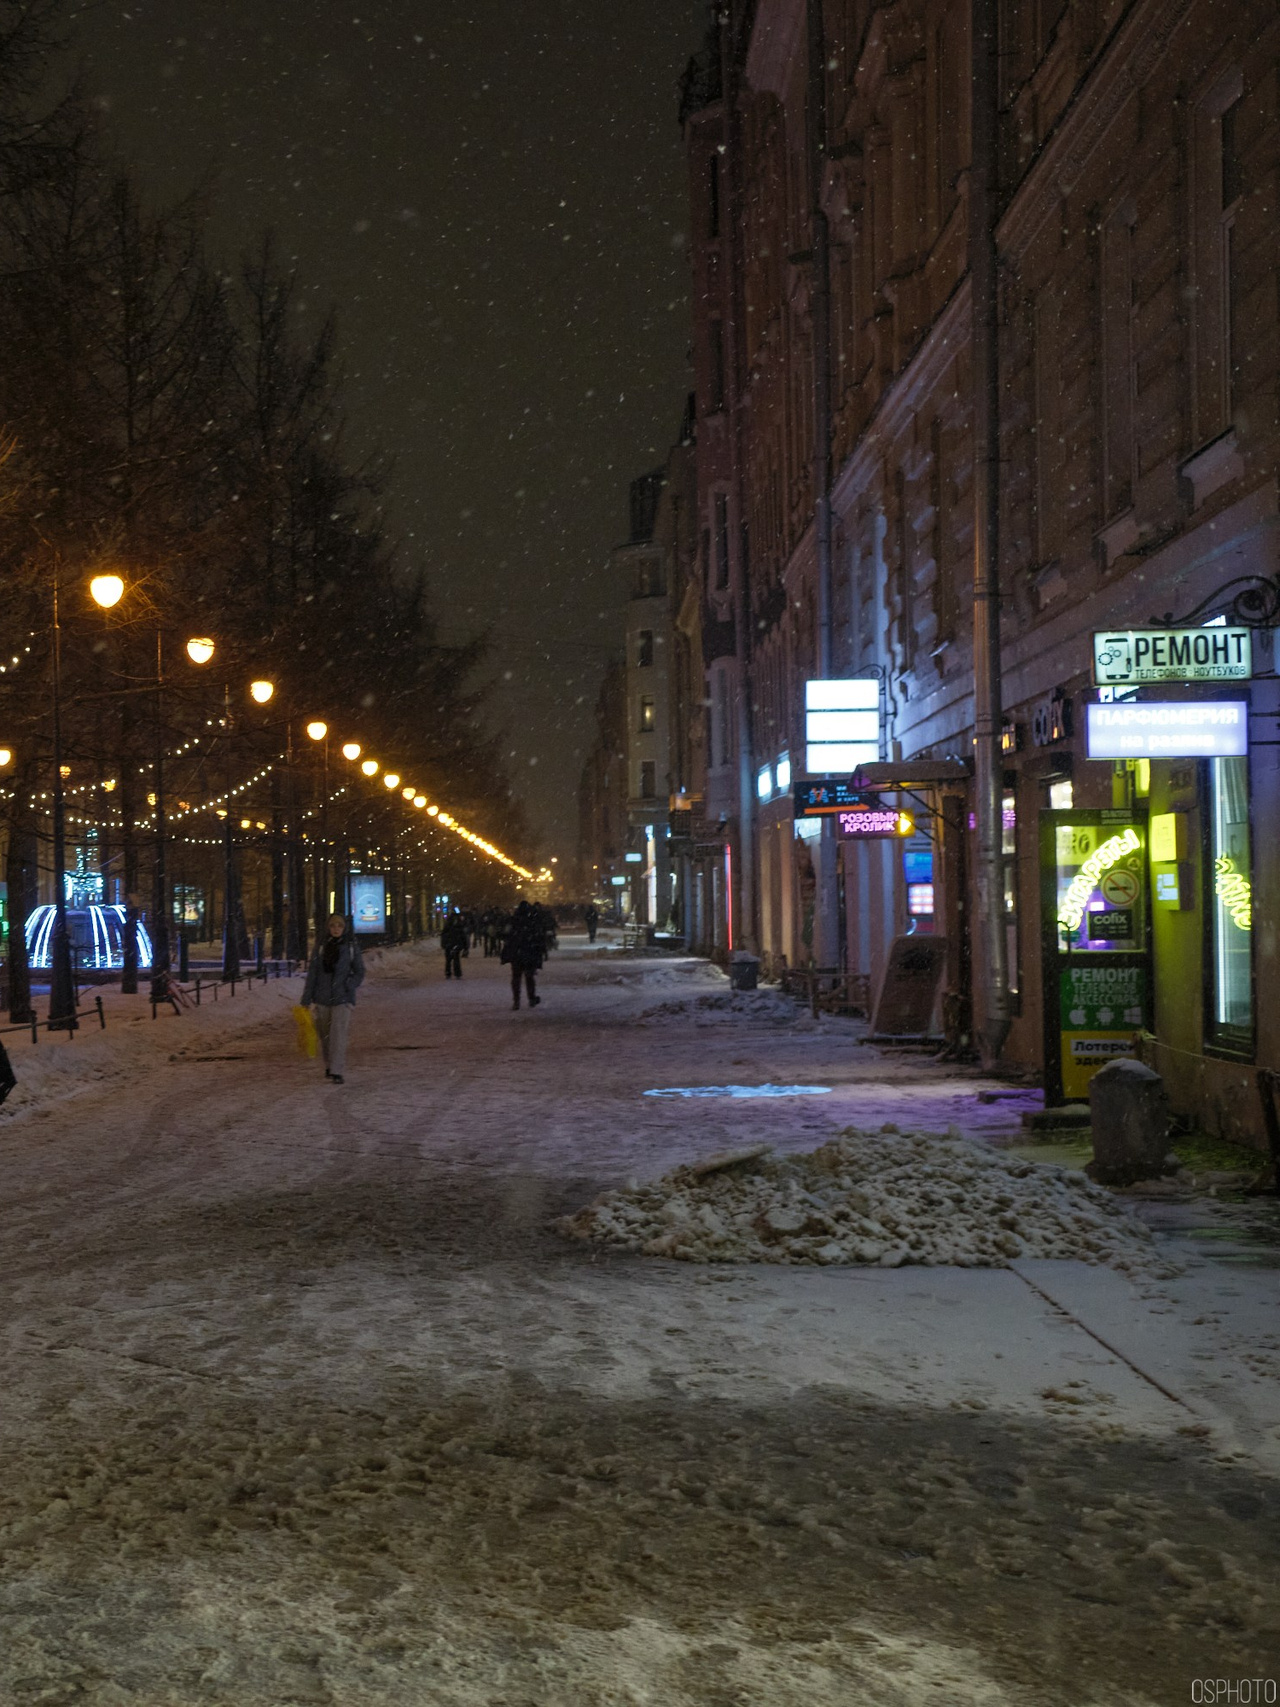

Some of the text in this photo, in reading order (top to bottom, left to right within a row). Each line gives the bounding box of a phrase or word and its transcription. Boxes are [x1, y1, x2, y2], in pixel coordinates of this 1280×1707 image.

[1135, 633, 1247, 668] РЕМОНТ
[1135, 666, 1246, 679] ТЕЛЕФОНОВ НОУТБУКОВ
[1096, 708, 1239, 726] ПАРФЮМЕРИЯ
[1120, 734, 1215, 751] на разлив
[840, 811, 899, 824] РОЗОВЫЙ
[844, 821, 895, 833] КРОЛИК
[1093, 912, 1127, 925] cofix
[1070, 967, 1140, 983] РЕМОНТ
[1073, 982, 1137, 994] ТЕЛЕФОНОВ
[1071, 994, 1140, 1006] АКСЕССУАРЫ
[1073, 1041, 1134, 1054] Лотере
